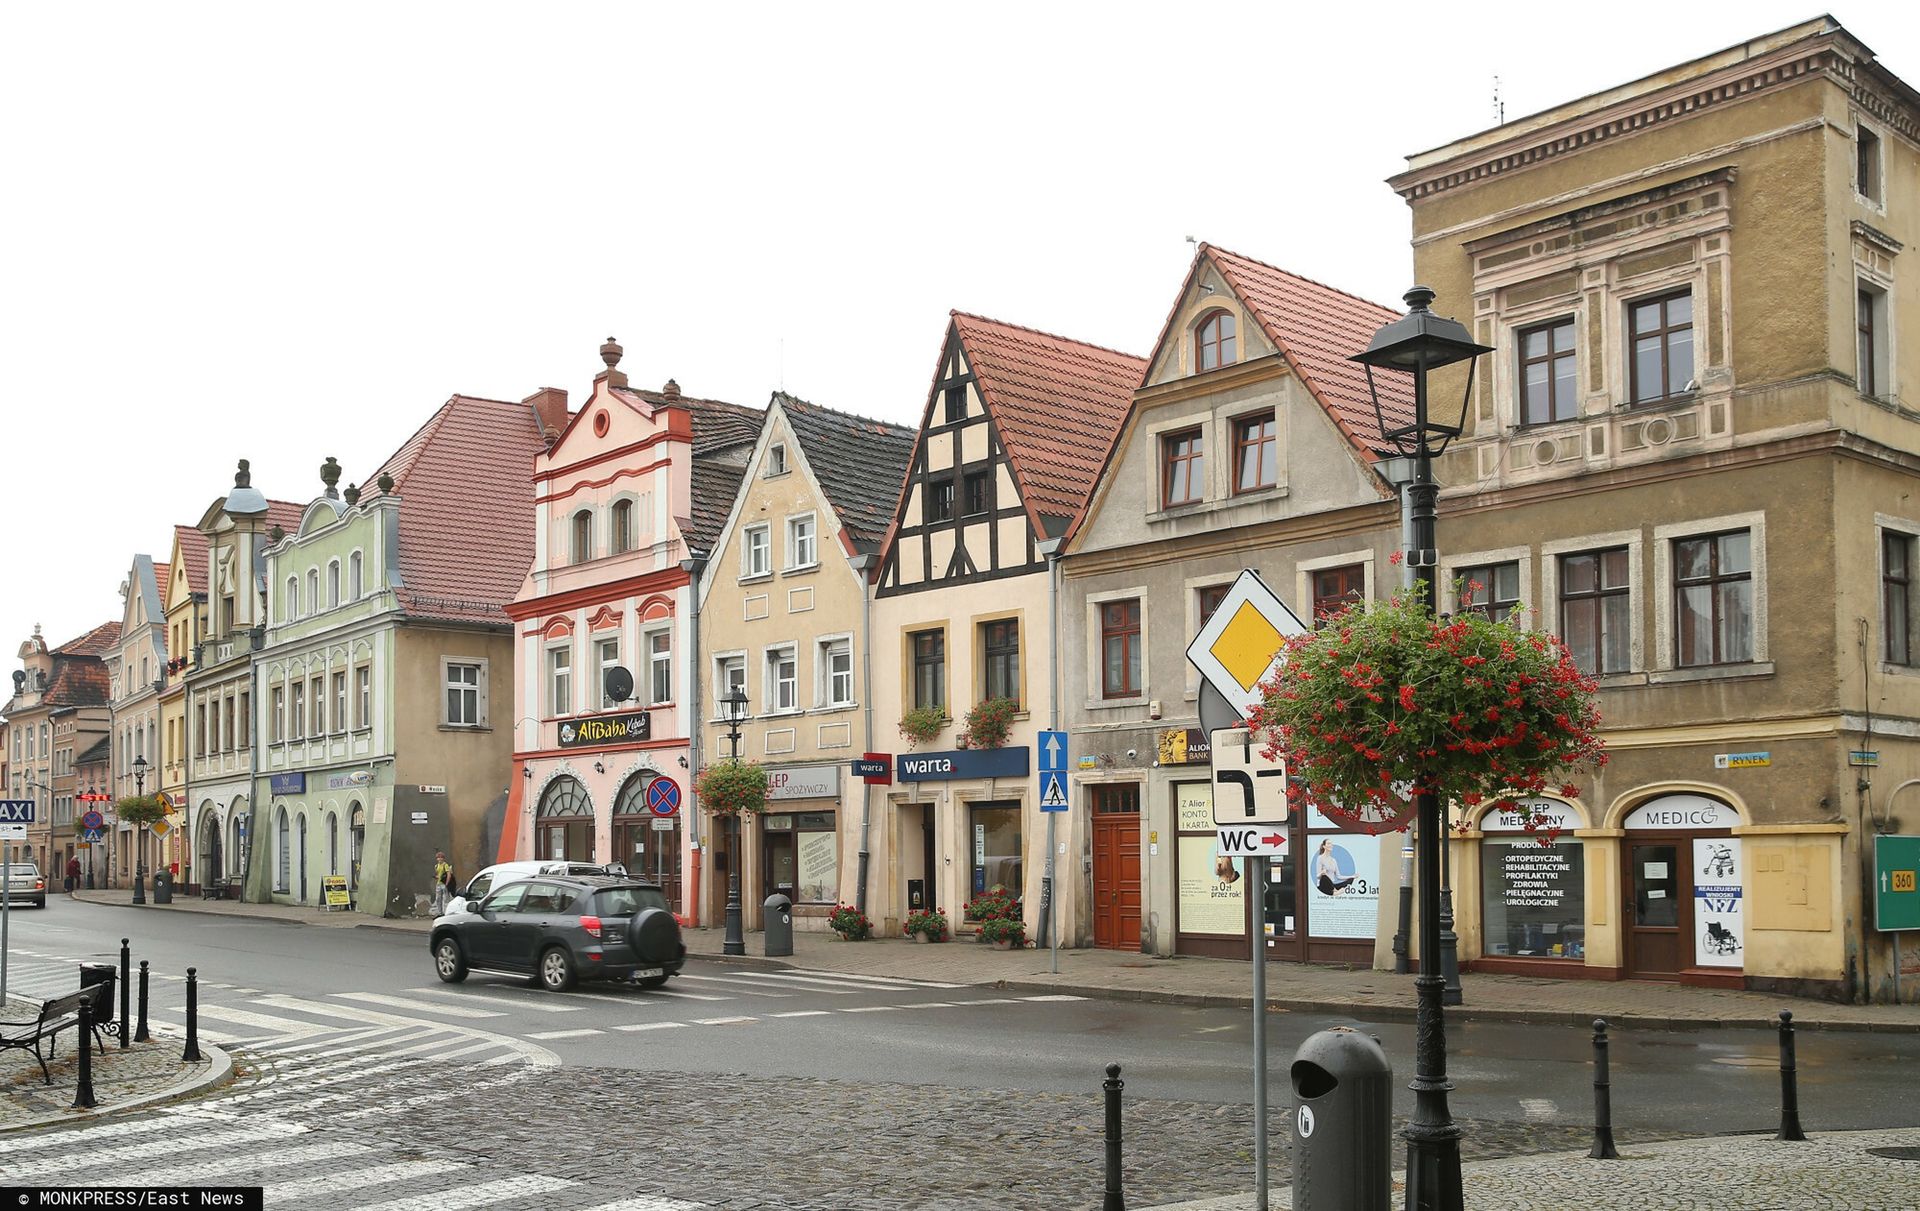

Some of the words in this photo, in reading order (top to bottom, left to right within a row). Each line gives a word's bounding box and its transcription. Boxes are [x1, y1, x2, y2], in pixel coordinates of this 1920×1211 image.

[578, 720, 627, 742] AliBaba
[627, 715, 646, 733] Kebab
[1188, 743, 1211, 752] ALIOR
[1189, 752, 1209, 760] BANK
[1733, 755, 1766, 765] RYNEK
[860, 763, 884, 772] warta
[905, 758, 951, 774] warta
[769, 773, 789, 788] LEP
[1182, 800, 1187, 808] Z
[1188, 799, 1206, 808] Alior
[0, 803, 32, 820] AXI
[1182, 810, 1208, 818] KONTO
[1186, 821, 1210, 829] KARTA
[1220, 830, 1258, 851] WC
[1345, 886, 1356, 894] do
[1358, 879, 1367, 894] 3
[1369, 886, 1379, 894] lat
[1895, 873, 1912, 888] 360
[1506, 889, 1564, 898] PIELĘGNACYJNE
[1703, 899, 1738, 913] NFZ
